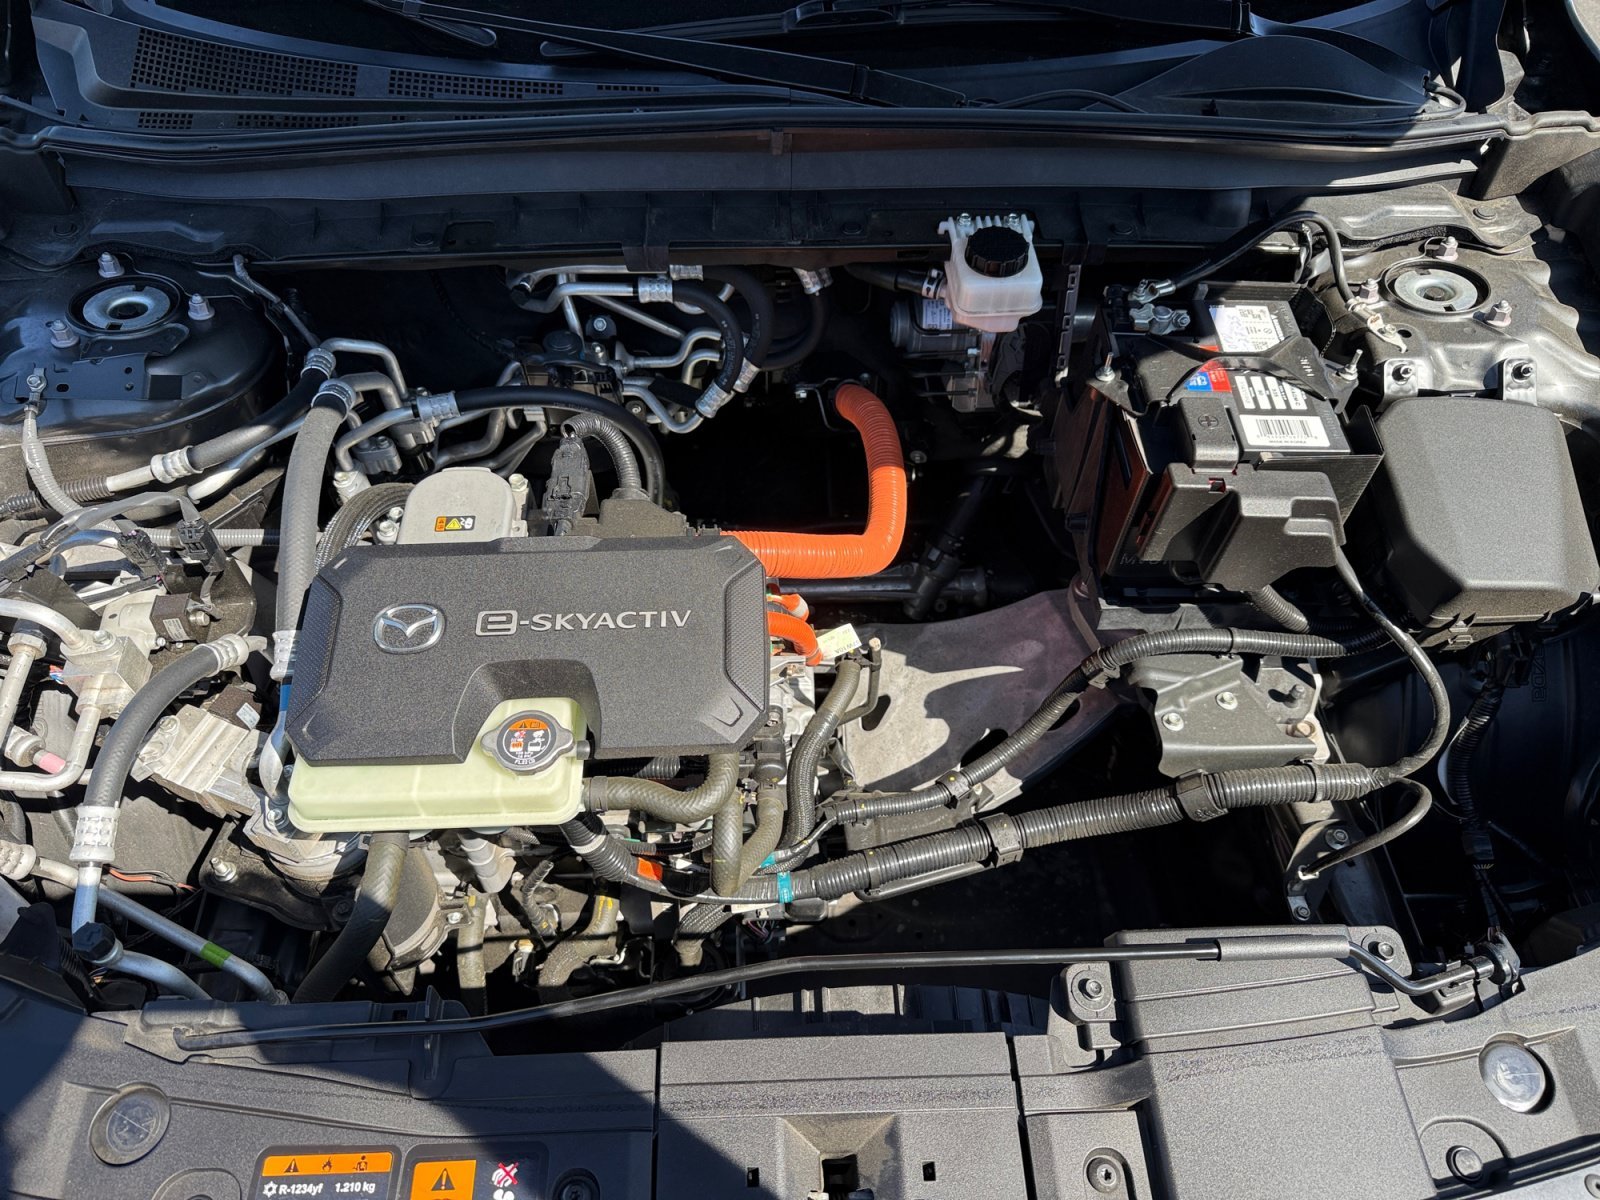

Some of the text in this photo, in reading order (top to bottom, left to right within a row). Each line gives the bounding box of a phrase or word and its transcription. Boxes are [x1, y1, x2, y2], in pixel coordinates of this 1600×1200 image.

[278, 1181, 376, 1196] R-1234yf 1.210 kg
